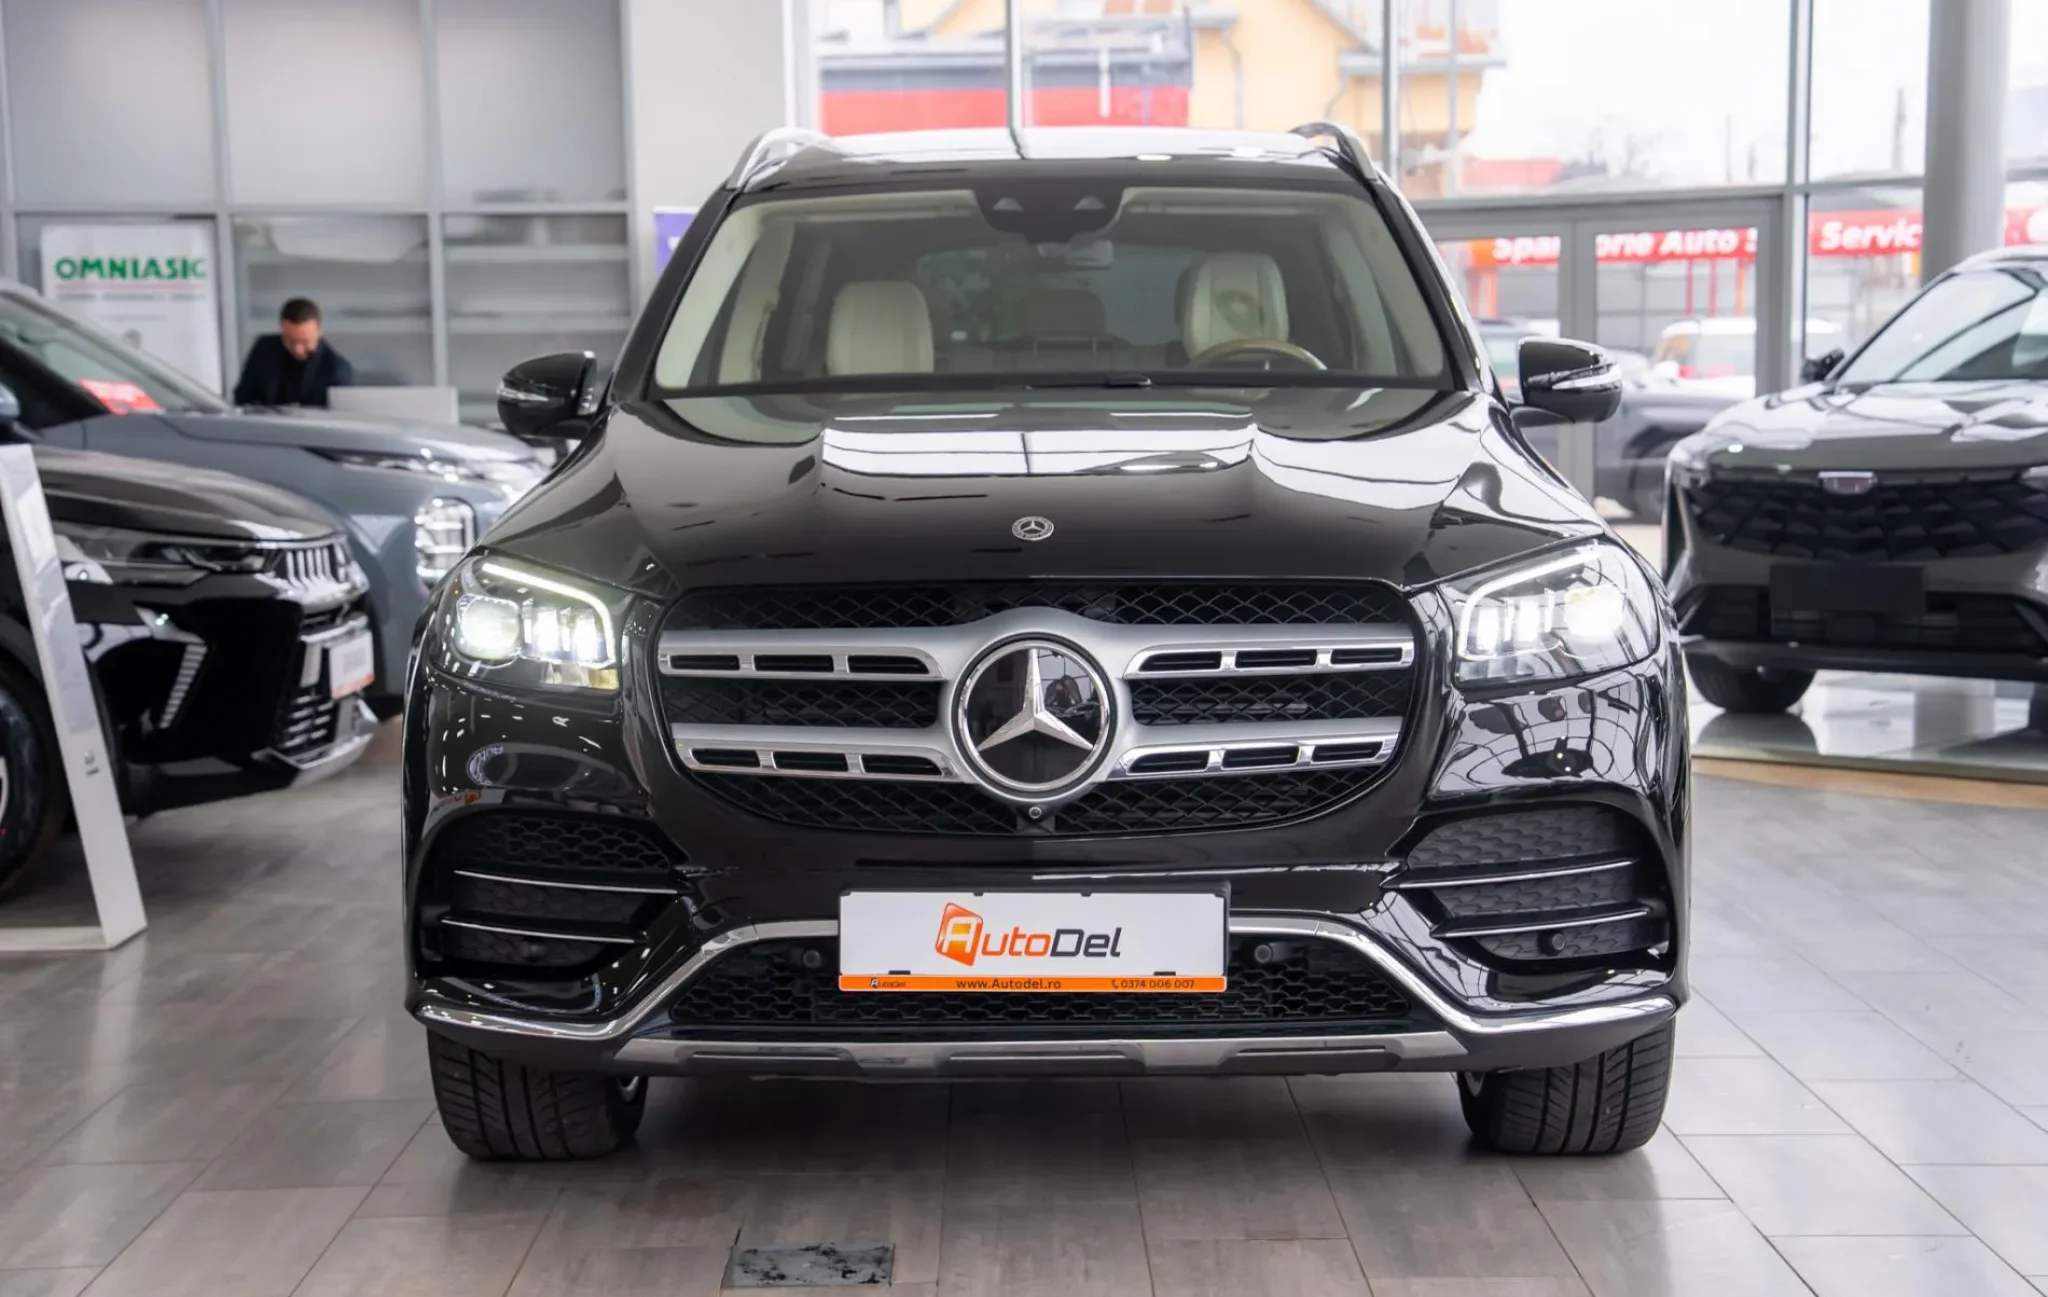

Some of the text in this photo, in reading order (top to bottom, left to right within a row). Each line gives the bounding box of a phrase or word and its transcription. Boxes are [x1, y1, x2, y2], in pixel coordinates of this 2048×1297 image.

[1658, 228, 1739, 256] Auto
[937, 907, 1122, 959] AutoDel
[956, 978, 1062, 990] www.Autodel.ro
[1121, 978, 1195, 989] 0374 006 007
